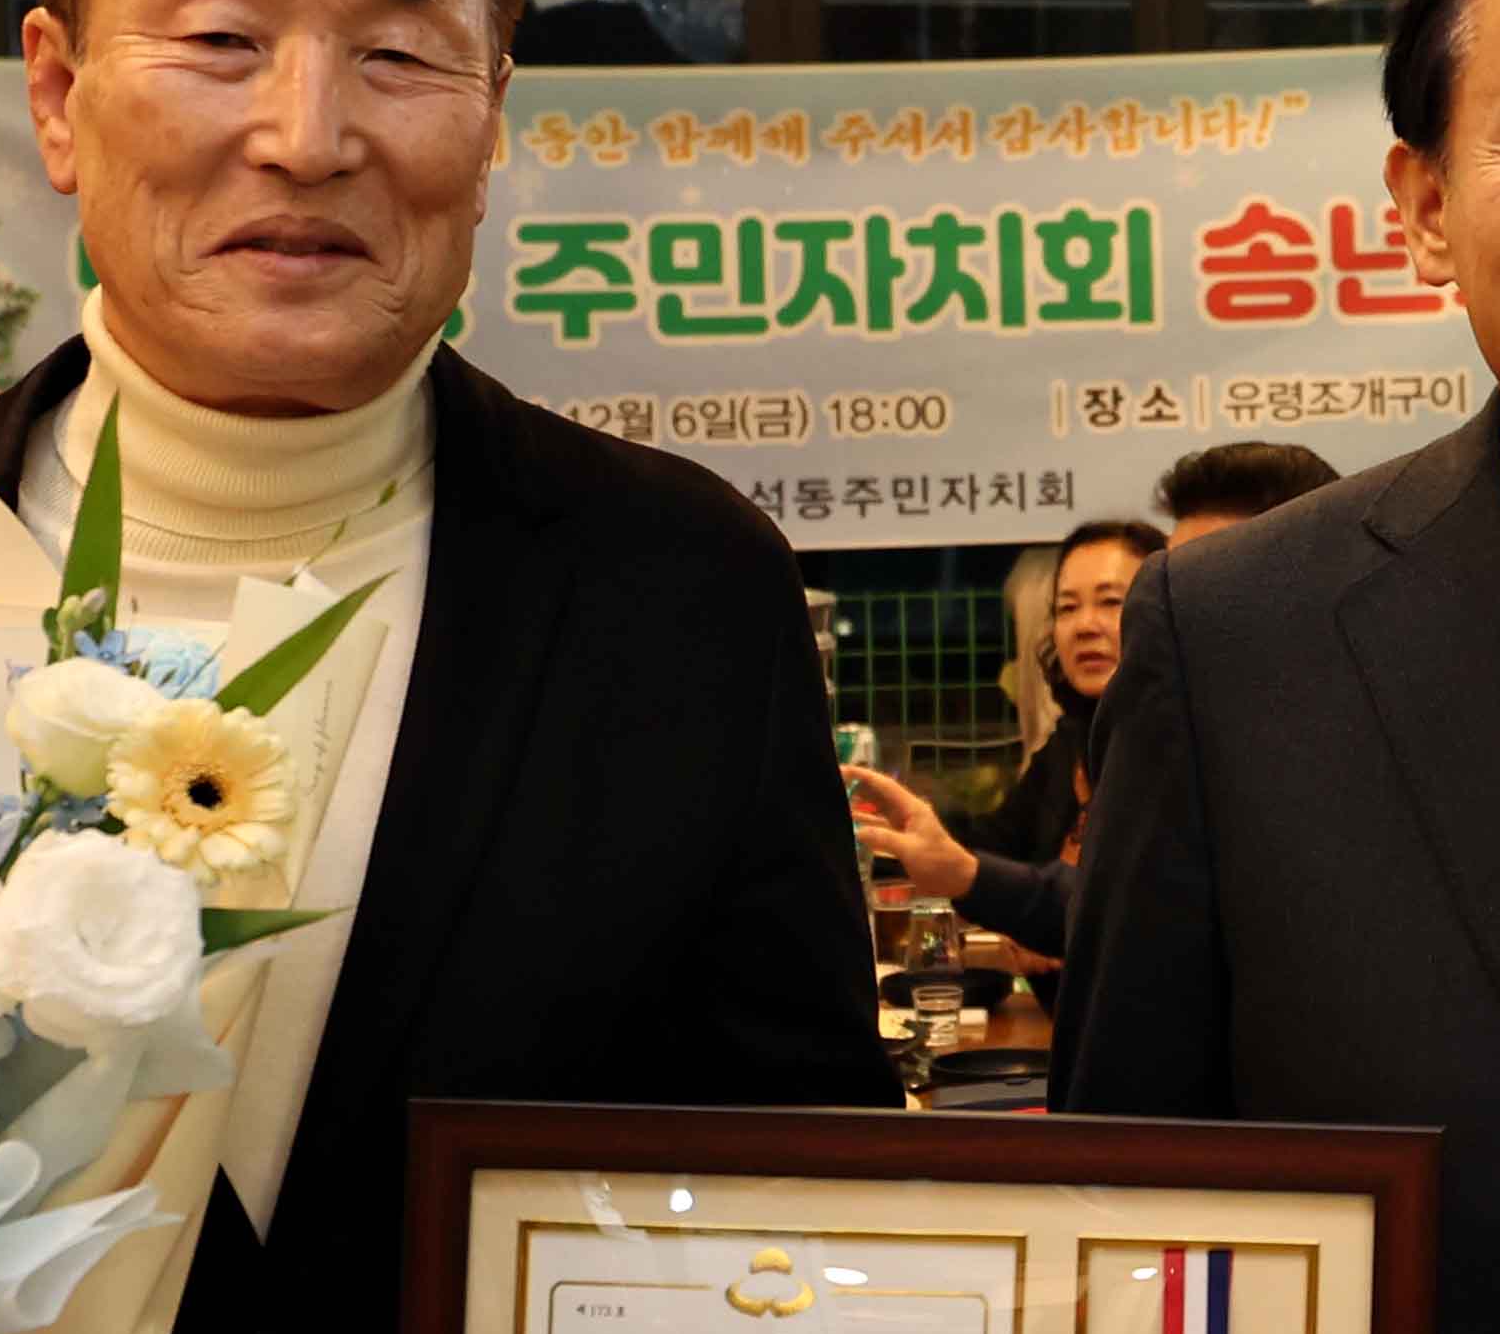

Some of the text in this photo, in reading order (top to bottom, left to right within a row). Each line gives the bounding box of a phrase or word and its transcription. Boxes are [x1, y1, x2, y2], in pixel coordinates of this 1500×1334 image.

[524, 113, 637, 165] 동안
[651, 111, 809, 165] 함께해
[512, 202, 1469, 341] 주민자치회 송년
[671, 395, 809, 442] 6일(금)
[828, 395, 947, 433] 18:00
[1225, 373, 1468, 424] 유령조개구이
